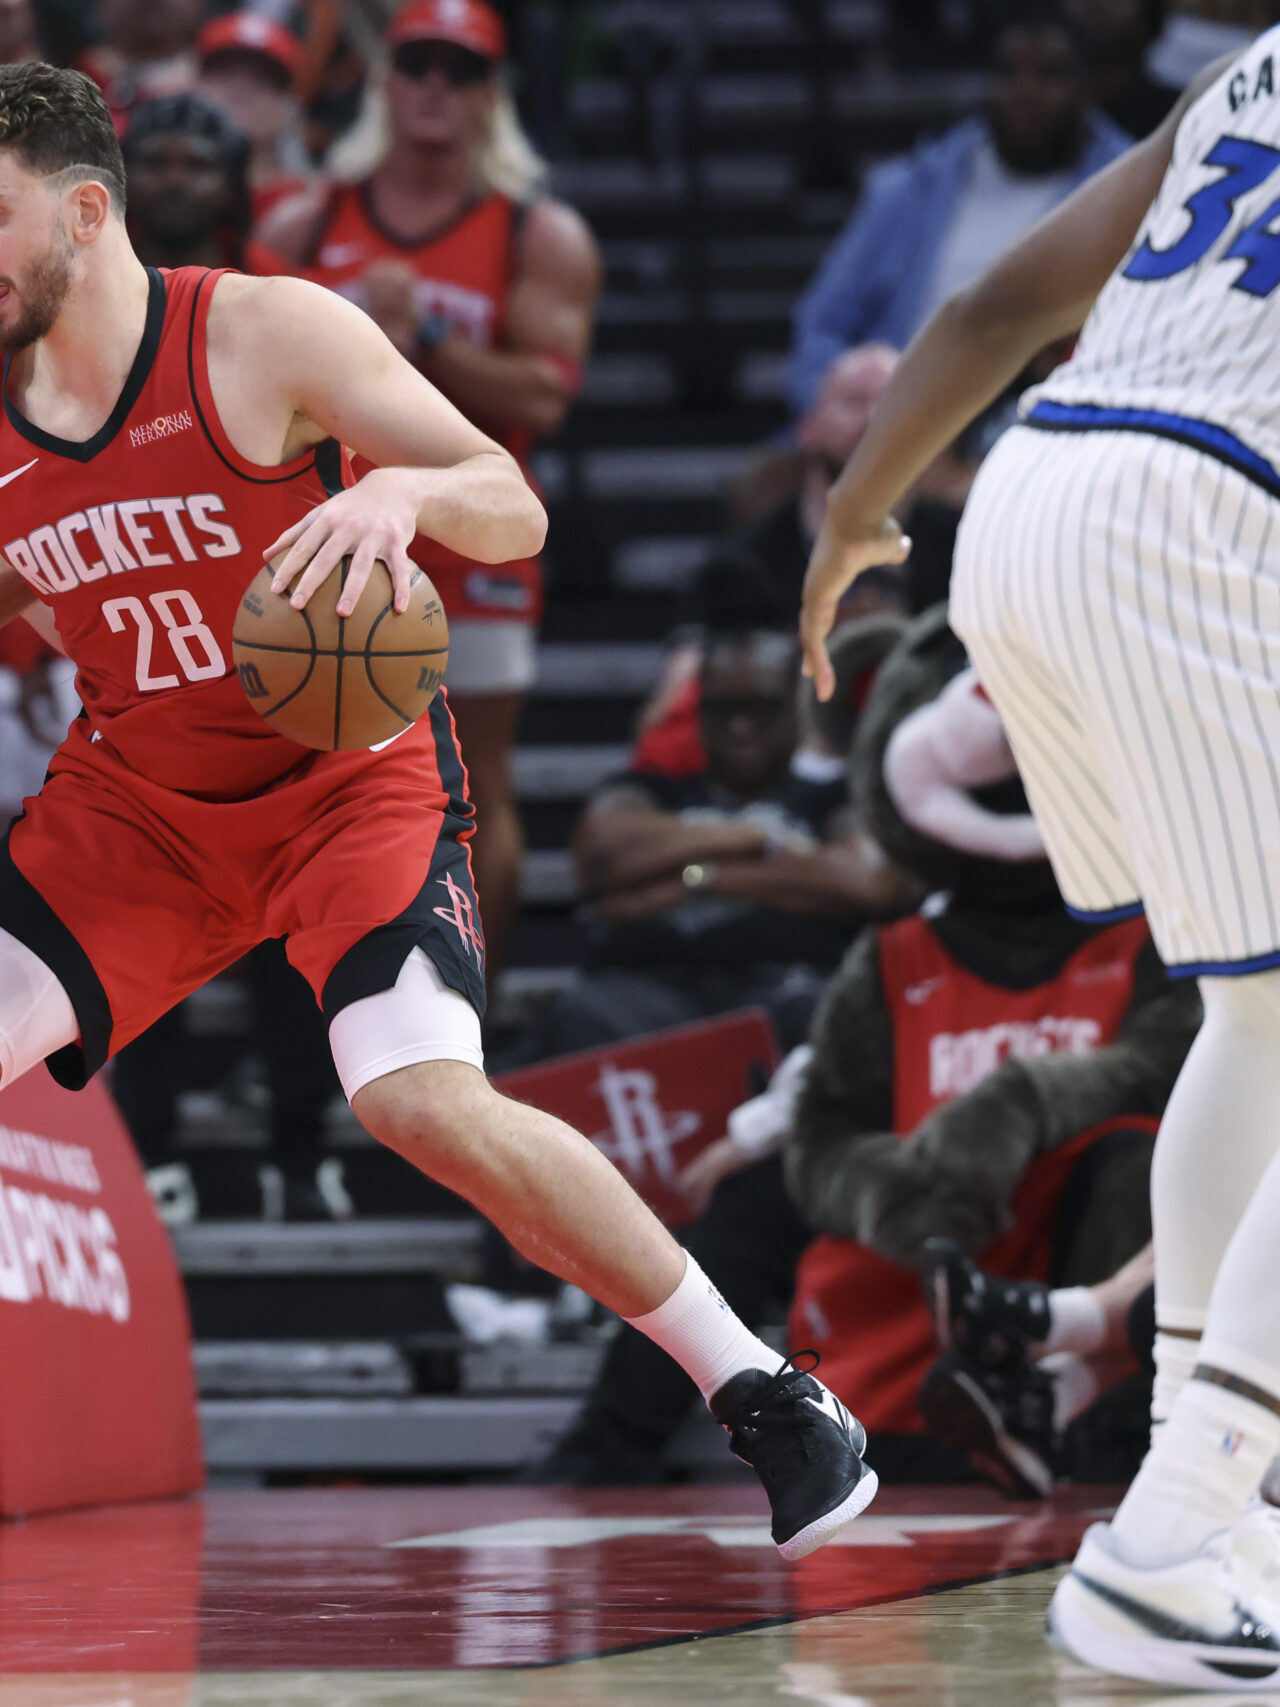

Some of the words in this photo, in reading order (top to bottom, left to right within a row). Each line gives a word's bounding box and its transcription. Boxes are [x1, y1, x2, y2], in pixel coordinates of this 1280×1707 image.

[129, 410, 192, 439] MEMORIAL
[131, 415, 193, 447] HERMANN
[4, 493, 242, 594] ROCKETS
[102, 590, 226, 691] 28
